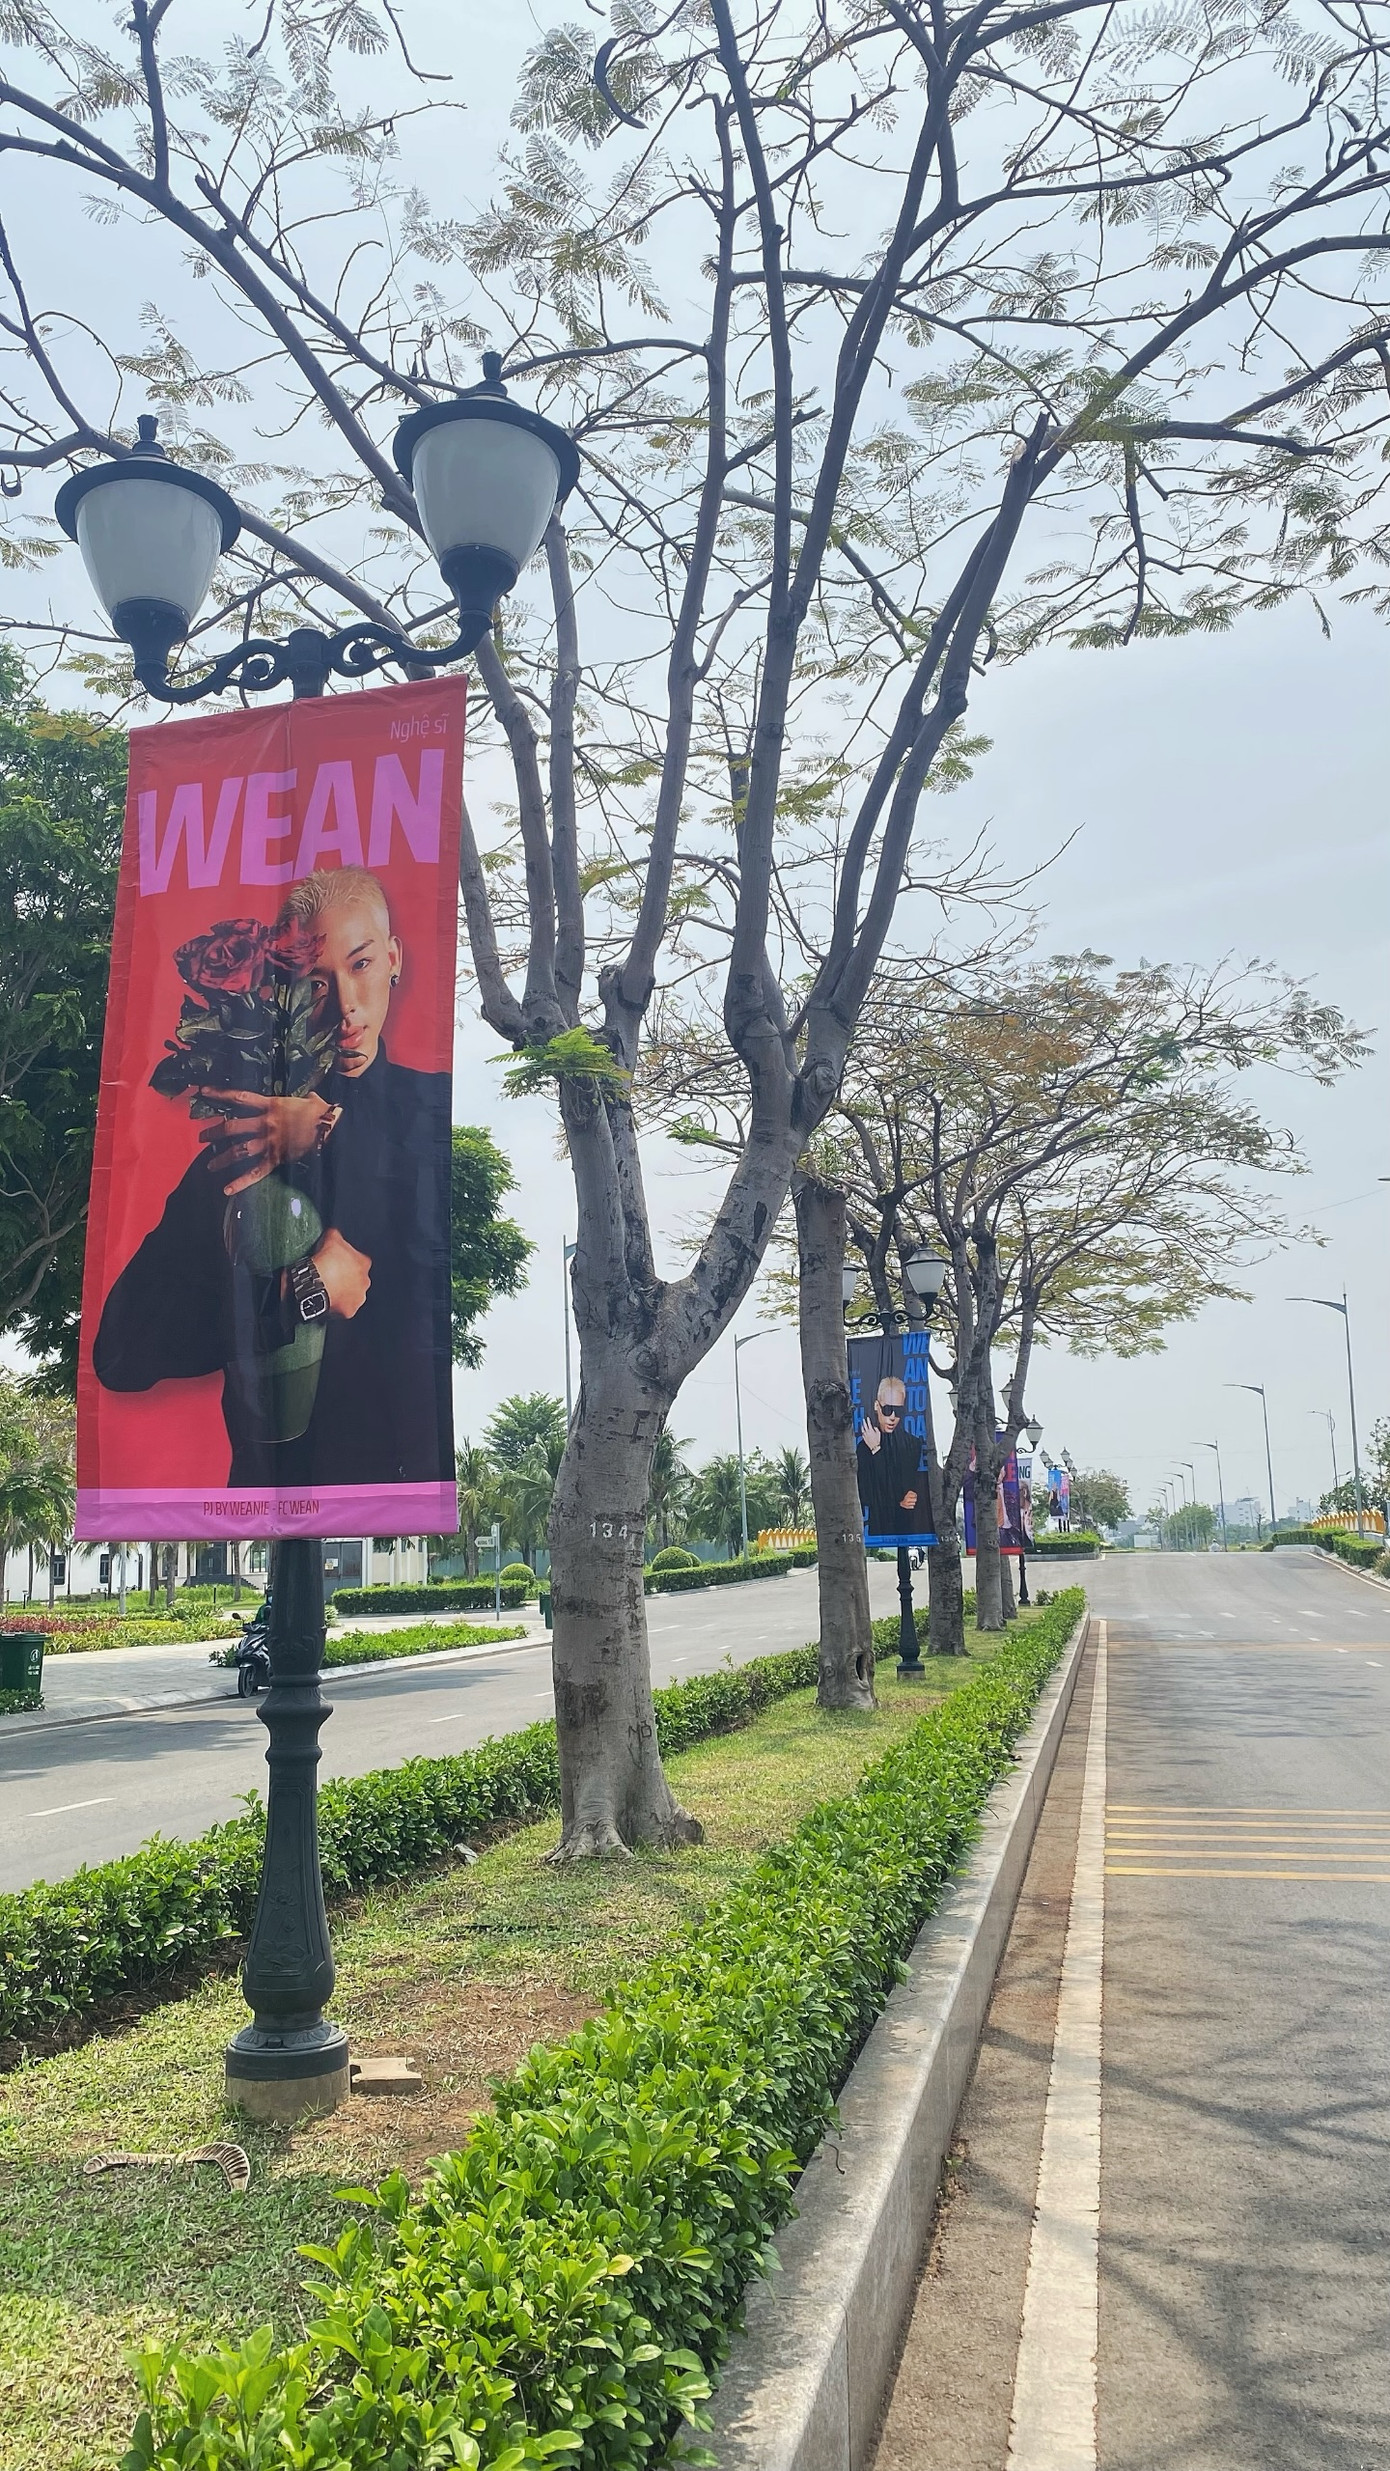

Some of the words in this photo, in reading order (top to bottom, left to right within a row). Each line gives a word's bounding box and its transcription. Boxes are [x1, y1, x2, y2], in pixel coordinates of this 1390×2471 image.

[390, 713, 430, 743] Nghệ
[433, 712, 450, 734] sĩ
[138, 749, 445, 897] WEAN
[904, 1357, 929, 1383] AN
[906, 1385, 927, 1412] TO
[203, 1502, 213, 1516] PJ
[215, 1502, 228, 1516] BY
[229, 1502, 269, 1516] WEANIE
[278, 1501, 289, 1516] FC
[289, 1500, 320, 1515] WEAN
[589, 1521, 628, 1540] 134
[842, 1533, 861, 1543] 135
